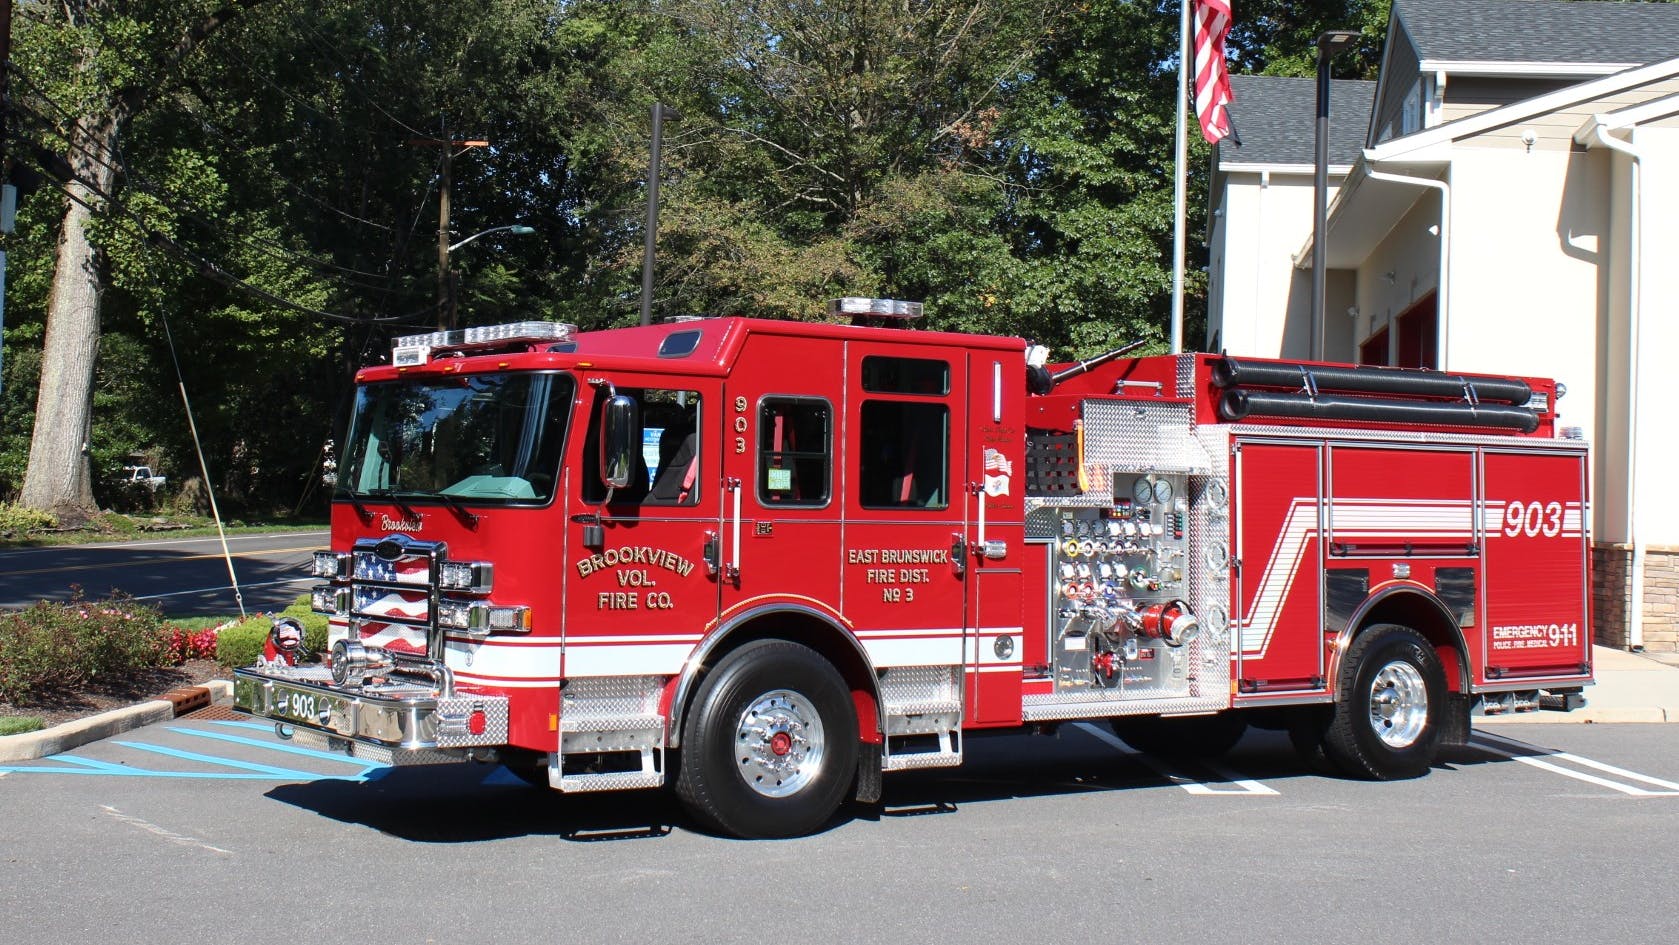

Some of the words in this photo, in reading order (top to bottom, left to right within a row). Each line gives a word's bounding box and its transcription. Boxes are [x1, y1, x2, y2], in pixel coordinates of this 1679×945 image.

[735, 396, 748, 454] 903
[1505, 500, 1562, 538] 903
[576, 546, 695, 577] BROOKVIEW
[848, 549, 879, 564] EAST
[882, 549, 948, 564] BRUNSWICK
[617, 569, 656, 587] VOL.
[866, 569, 896, 583] FIRE
[900, 569, 930, 583] DIST.
[598, 592, 638, 609] FIRE
[646, 592, 674, 609] CO.
[905, 588, 914, 602] 3
[1493, 625, 1548, 639] EMERGENCY
[292, 693, 315, 720] 903
